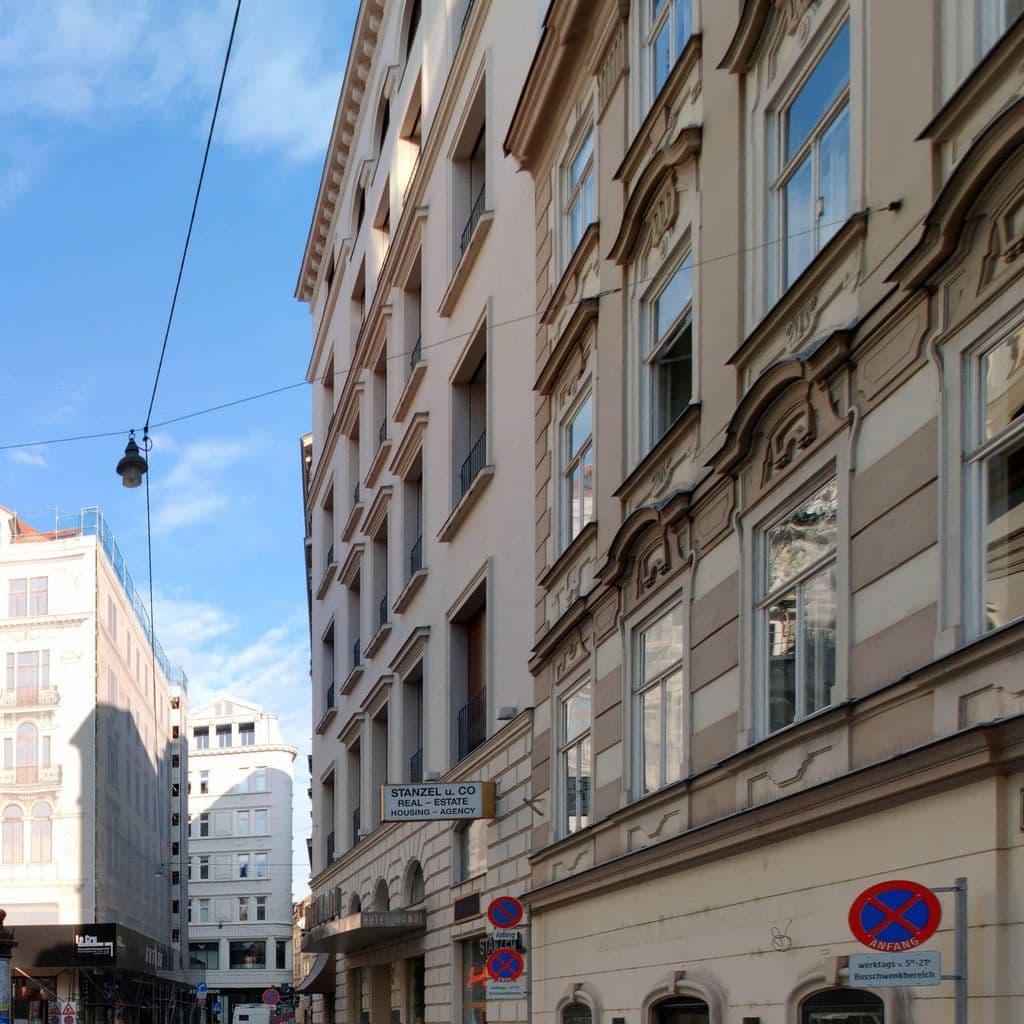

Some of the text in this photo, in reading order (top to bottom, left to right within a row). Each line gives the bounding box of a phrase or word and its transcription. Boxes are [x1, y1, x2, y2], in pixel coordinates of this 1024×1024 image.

[391, 786, 476, 798] STANZEL u. CO
[398, 800, 423, 808] REAL
[434, 798, 469, 807] ESTATE
[391, 809, 430, 817] HOUSING
[440, 807, 476, 816] AGENCY
[869, 937, 919, 951] ANFANG
[858, 961, 896, 969] werktags
[854, 970, 935, 980] Busschwenkbereich
